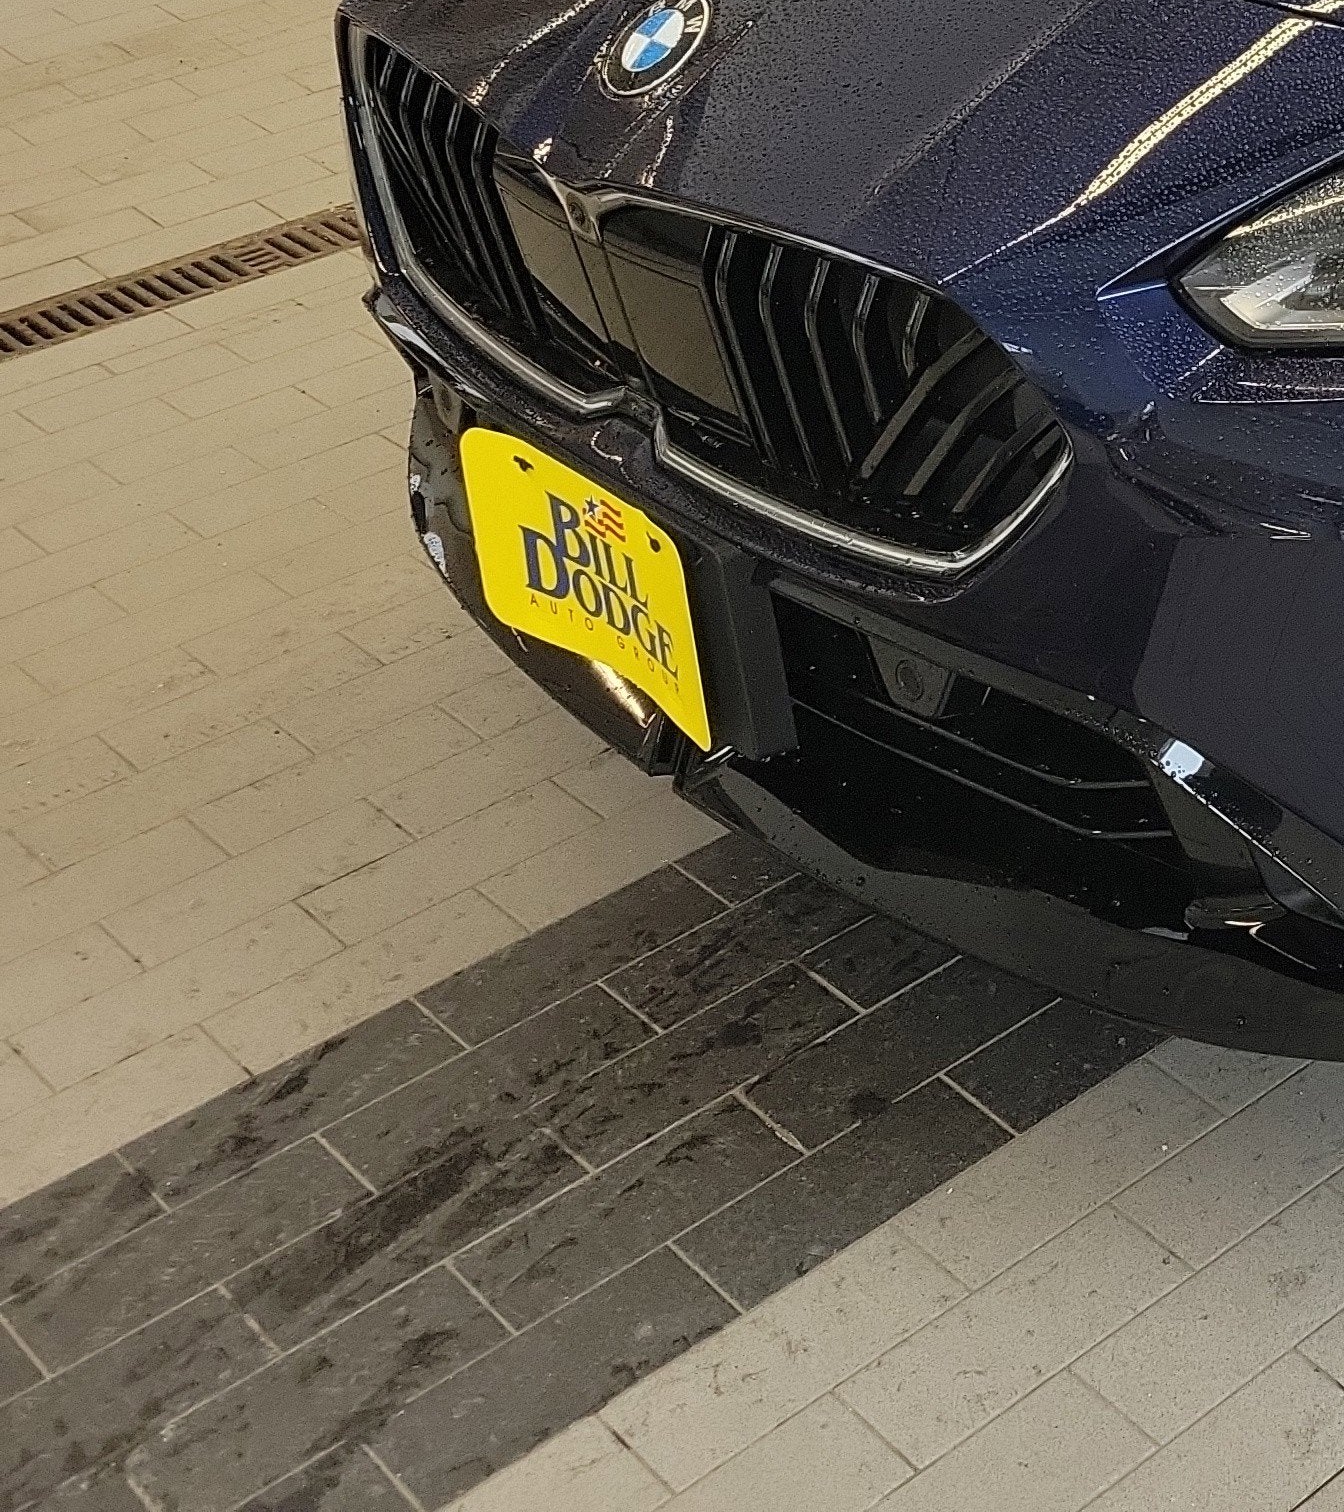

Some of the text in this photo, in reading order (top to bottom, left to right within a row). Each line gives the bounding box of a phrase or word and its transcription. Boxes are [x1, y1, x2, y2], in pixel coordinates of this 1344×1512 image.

[518, 524, 679, 681] DODGE
[545, 490, 649, 610] BILL
[529, 592, 679, 694] AUTO GROUP
